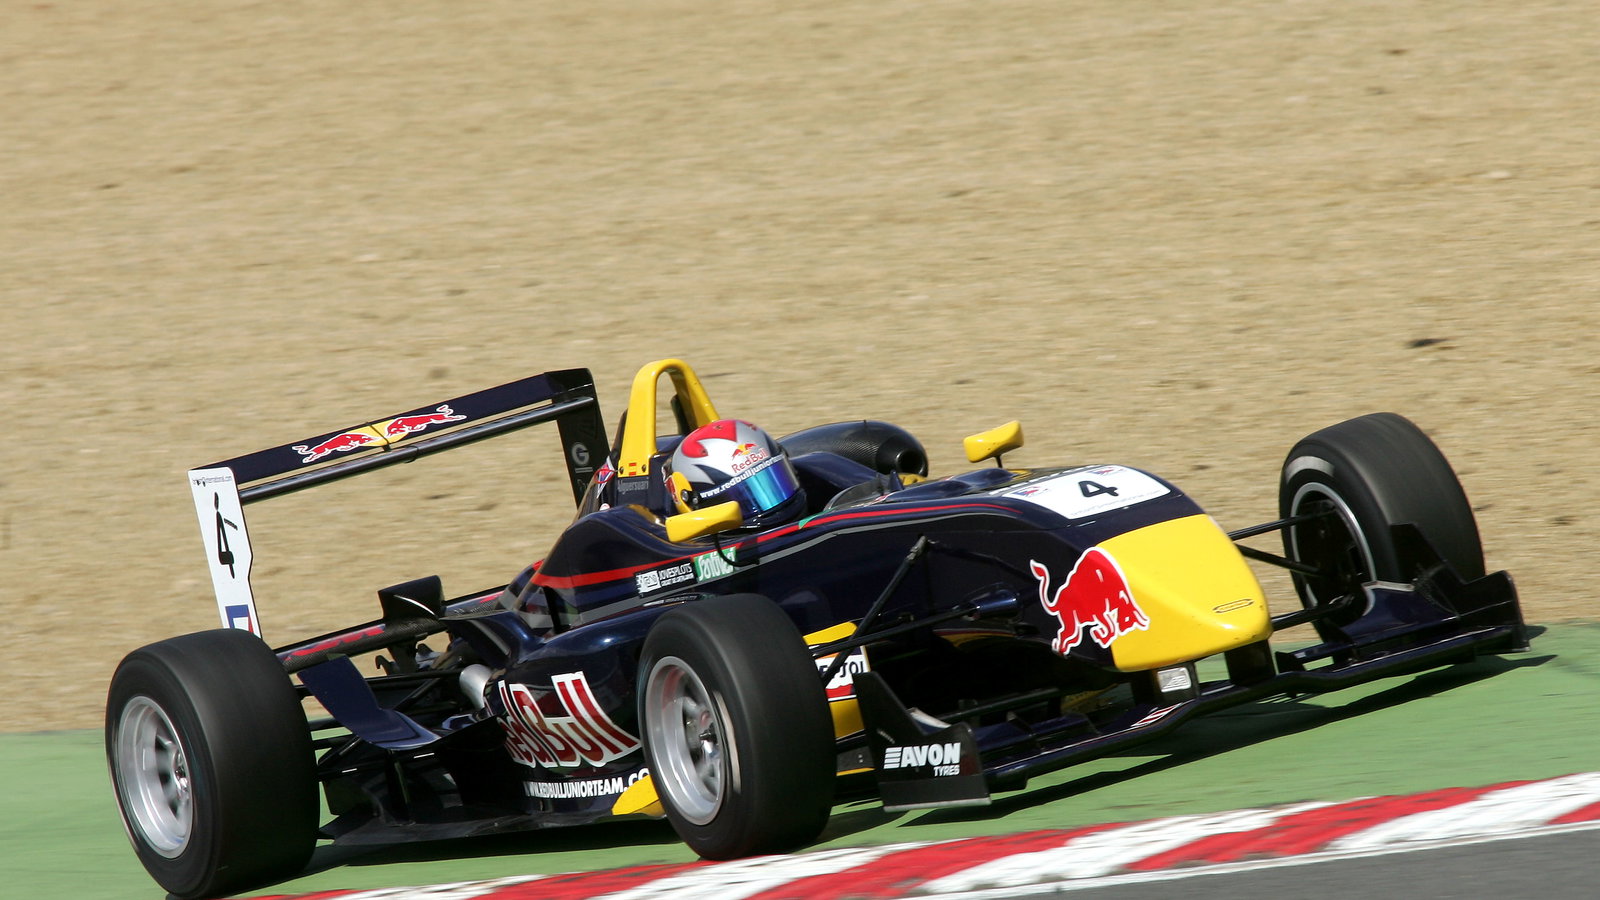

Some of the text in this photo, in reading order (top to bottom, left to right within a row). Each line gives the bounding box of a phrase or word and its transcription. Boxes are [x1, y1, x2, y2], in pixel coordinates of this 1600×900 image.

[1078, 480, 1119, 498] 4
[213, 492, 239, 579] 4
[901, 742, 962, 768] AVON
[933, 764, 961, 777] TYRES
